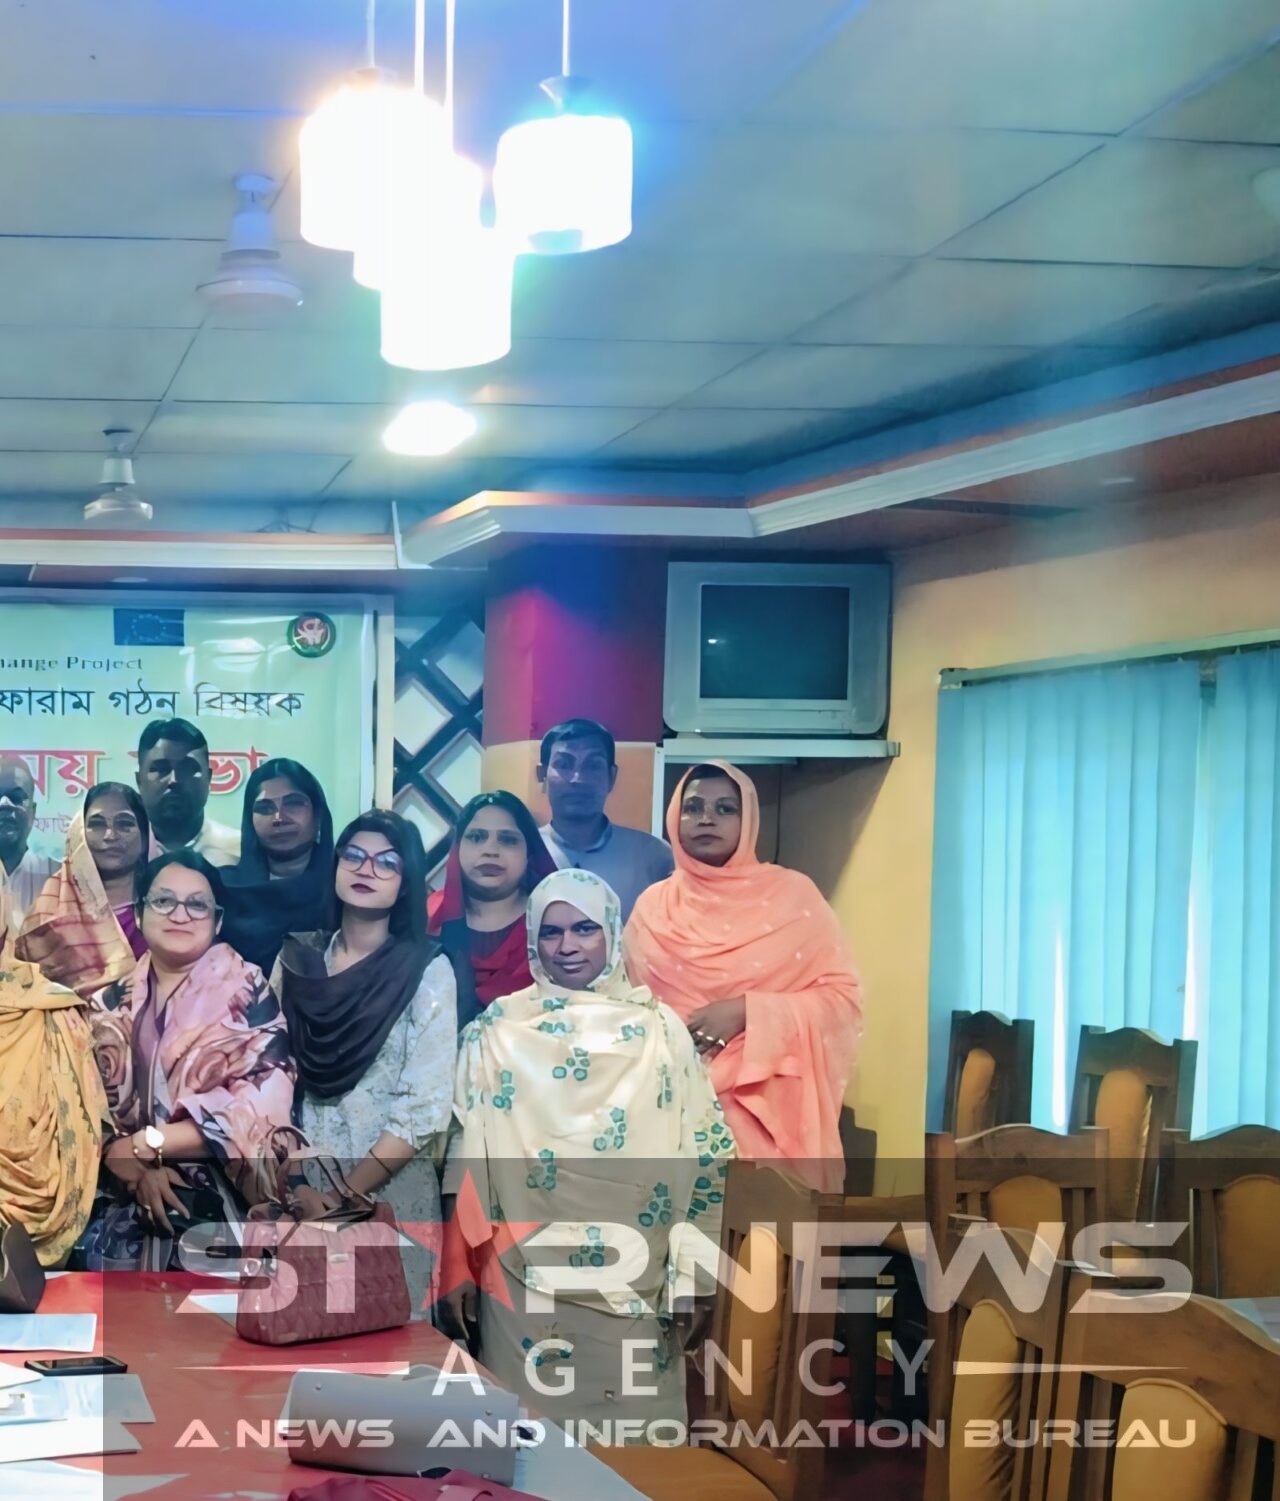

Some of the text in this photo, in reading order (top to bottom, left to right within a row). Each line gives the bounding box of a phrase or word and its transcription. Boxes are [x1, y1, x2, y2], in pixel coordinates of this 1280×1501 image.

[66, 656, 143, 672] Project
[108, 678, 181, 716] গঠন
[193, 681, 305, 717] বিষয়ক
[127, 744, 270, 797] ভা
